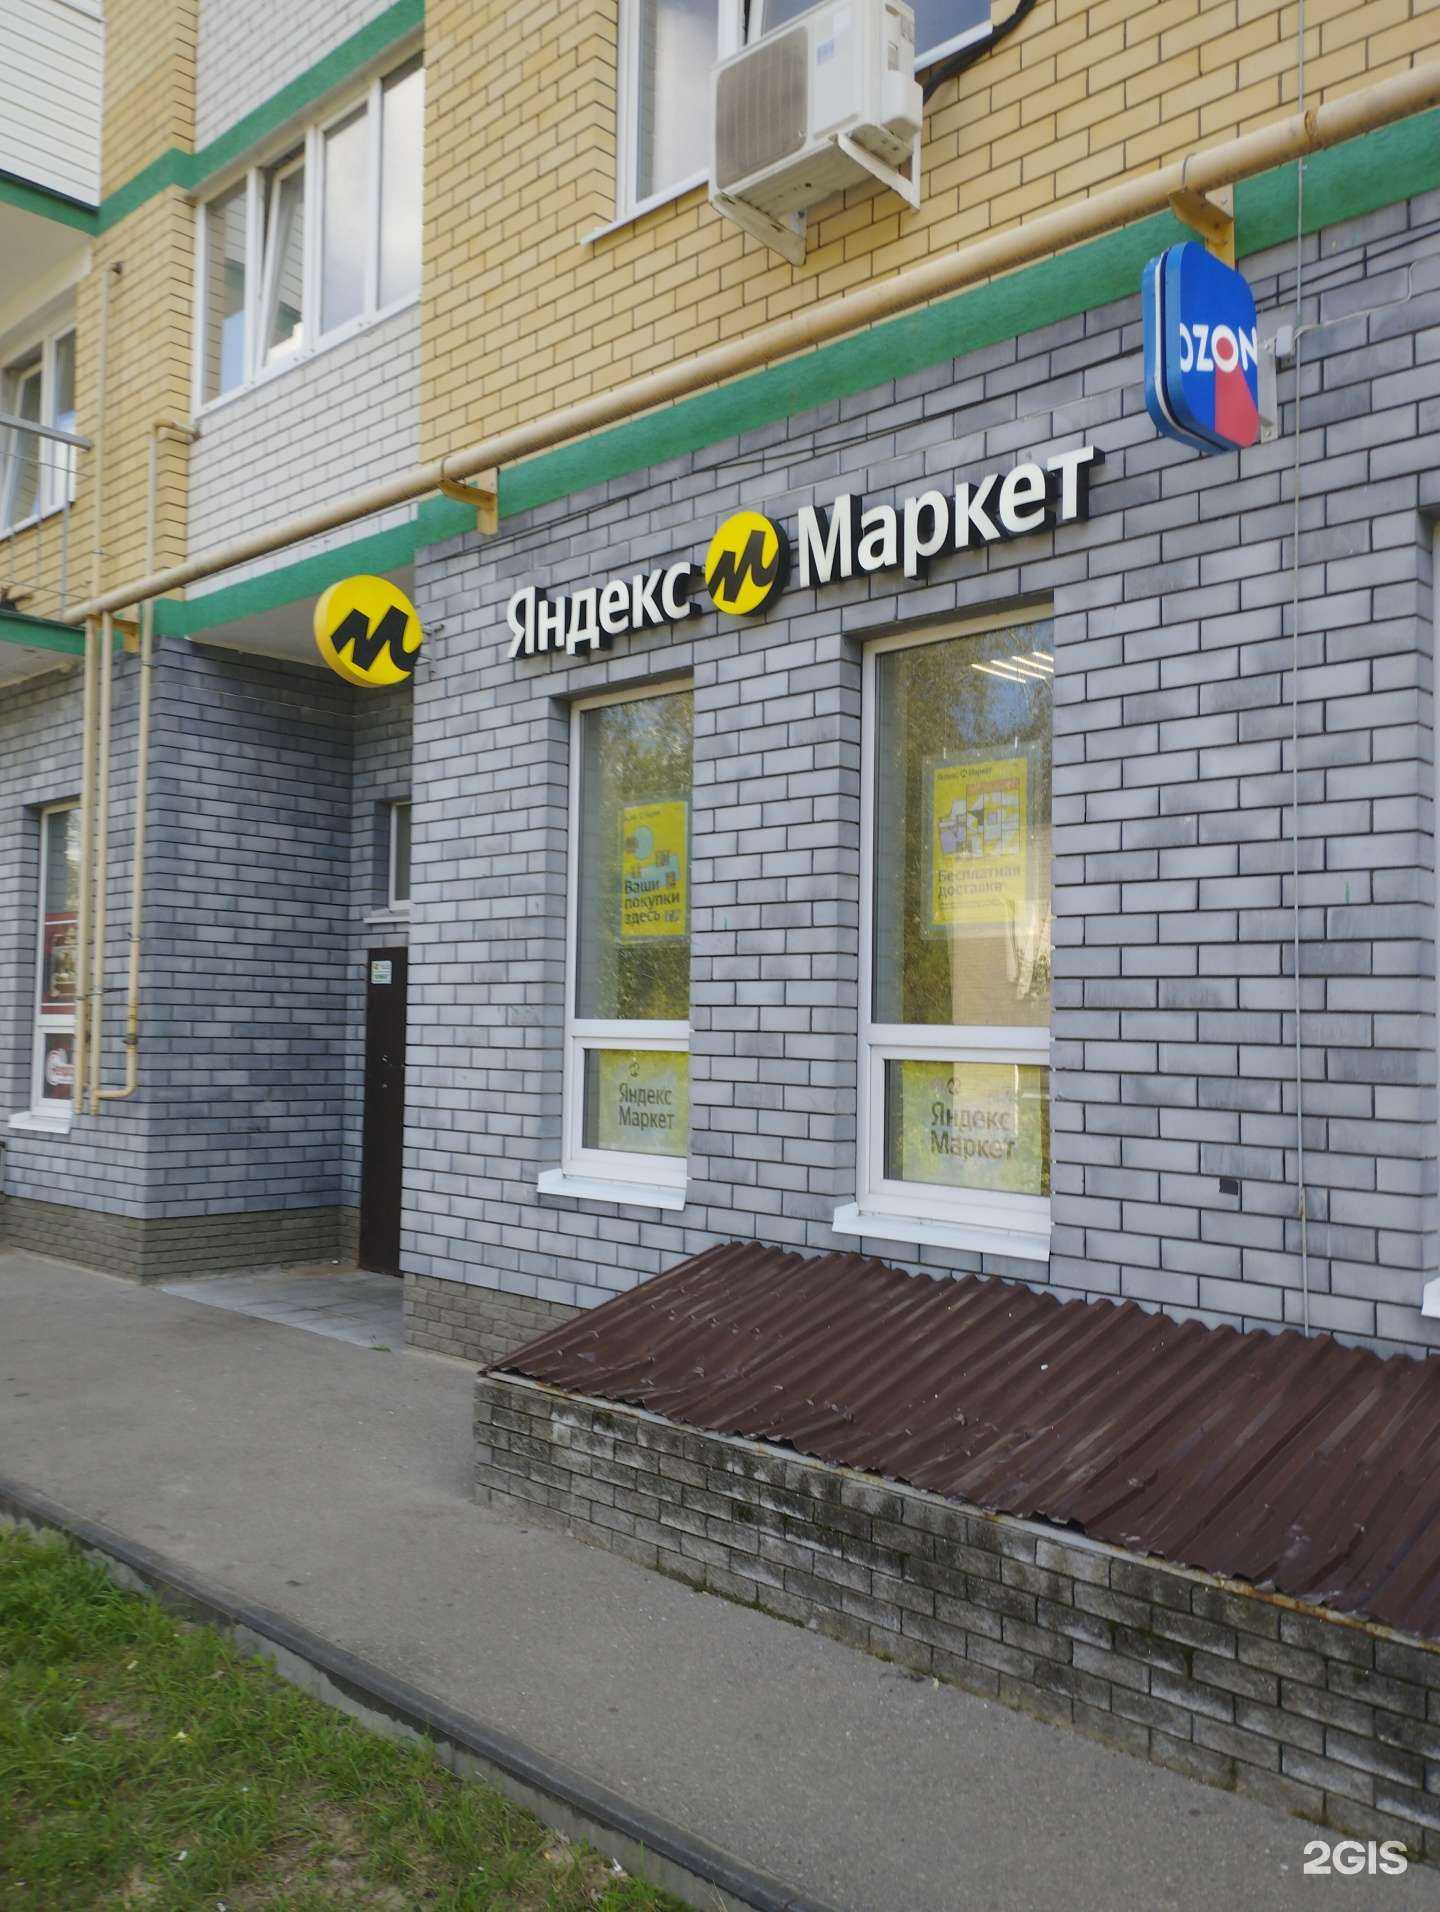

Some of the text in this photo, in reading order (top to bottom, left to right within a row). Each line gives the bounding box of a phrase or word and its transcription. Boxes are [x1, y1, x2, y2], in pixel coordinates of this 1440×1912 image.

[1179, 323, 1258, 373] OZON
[506, 561, 691, 659] Яндекс
[799, 446, 1095, 588] Маркет
[624, 879, 660, 894] Ваши
[624, 893, 680, 910] покупки
[624, 911, 660, 925] здесь
[619, 1082, 672, 1107] Яндекс
[619, 1105, 674, 1131] Маркет
[931, 1102, 1011, 1132] Яндекс
[931, 1130, 1015, 1160] Маркет
